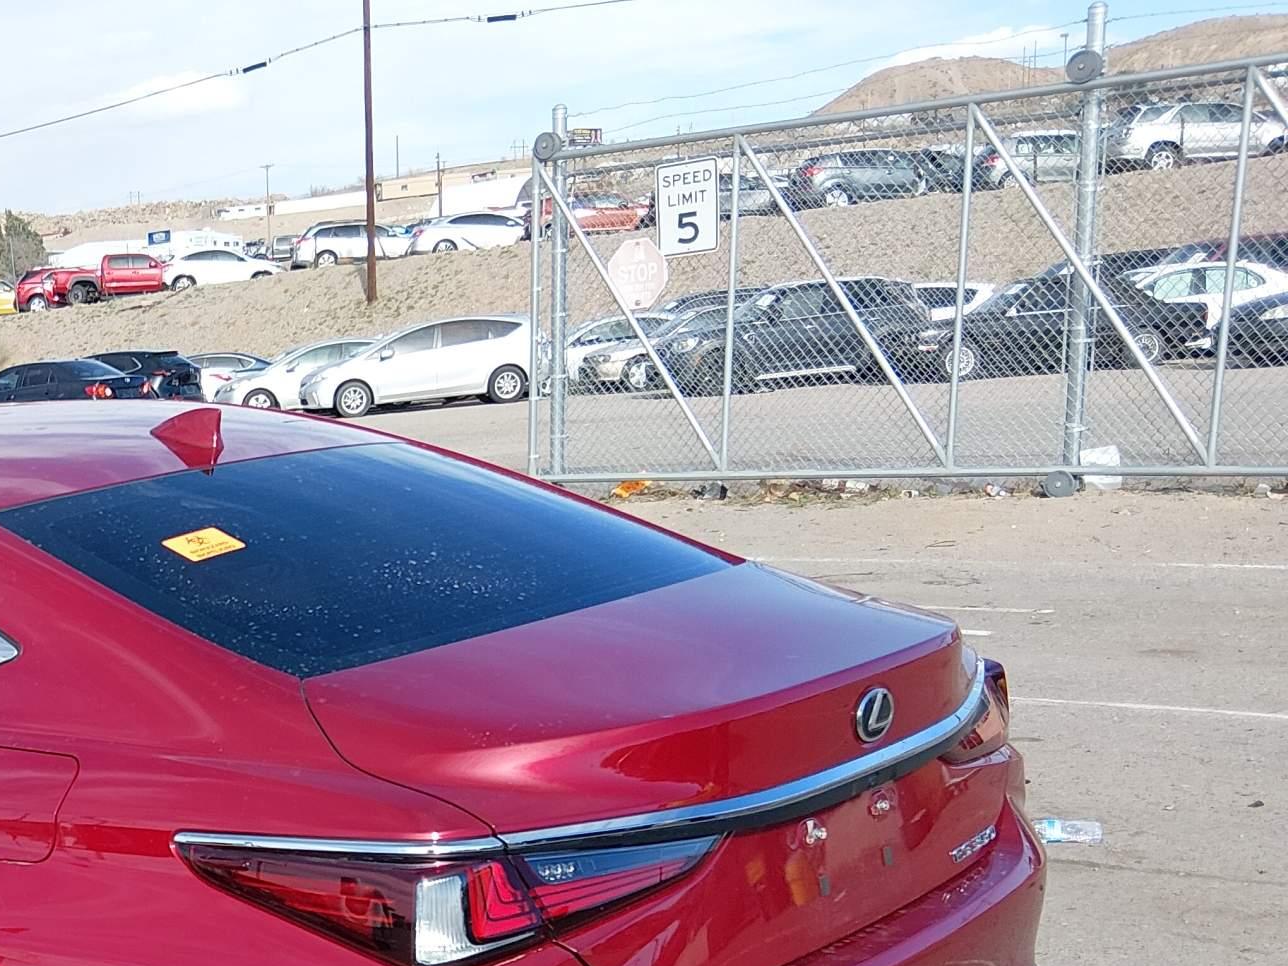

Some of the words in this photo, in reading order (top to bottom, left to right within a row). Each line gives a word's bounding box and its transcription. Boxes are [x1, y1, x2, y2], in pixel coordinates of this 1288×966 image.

[662, 169, 713, 189] SPEED
[667, 189, 708, 208] LIMIT
[677, 211, 700, 244] 5
[618, 262, 658, 282] STOP
